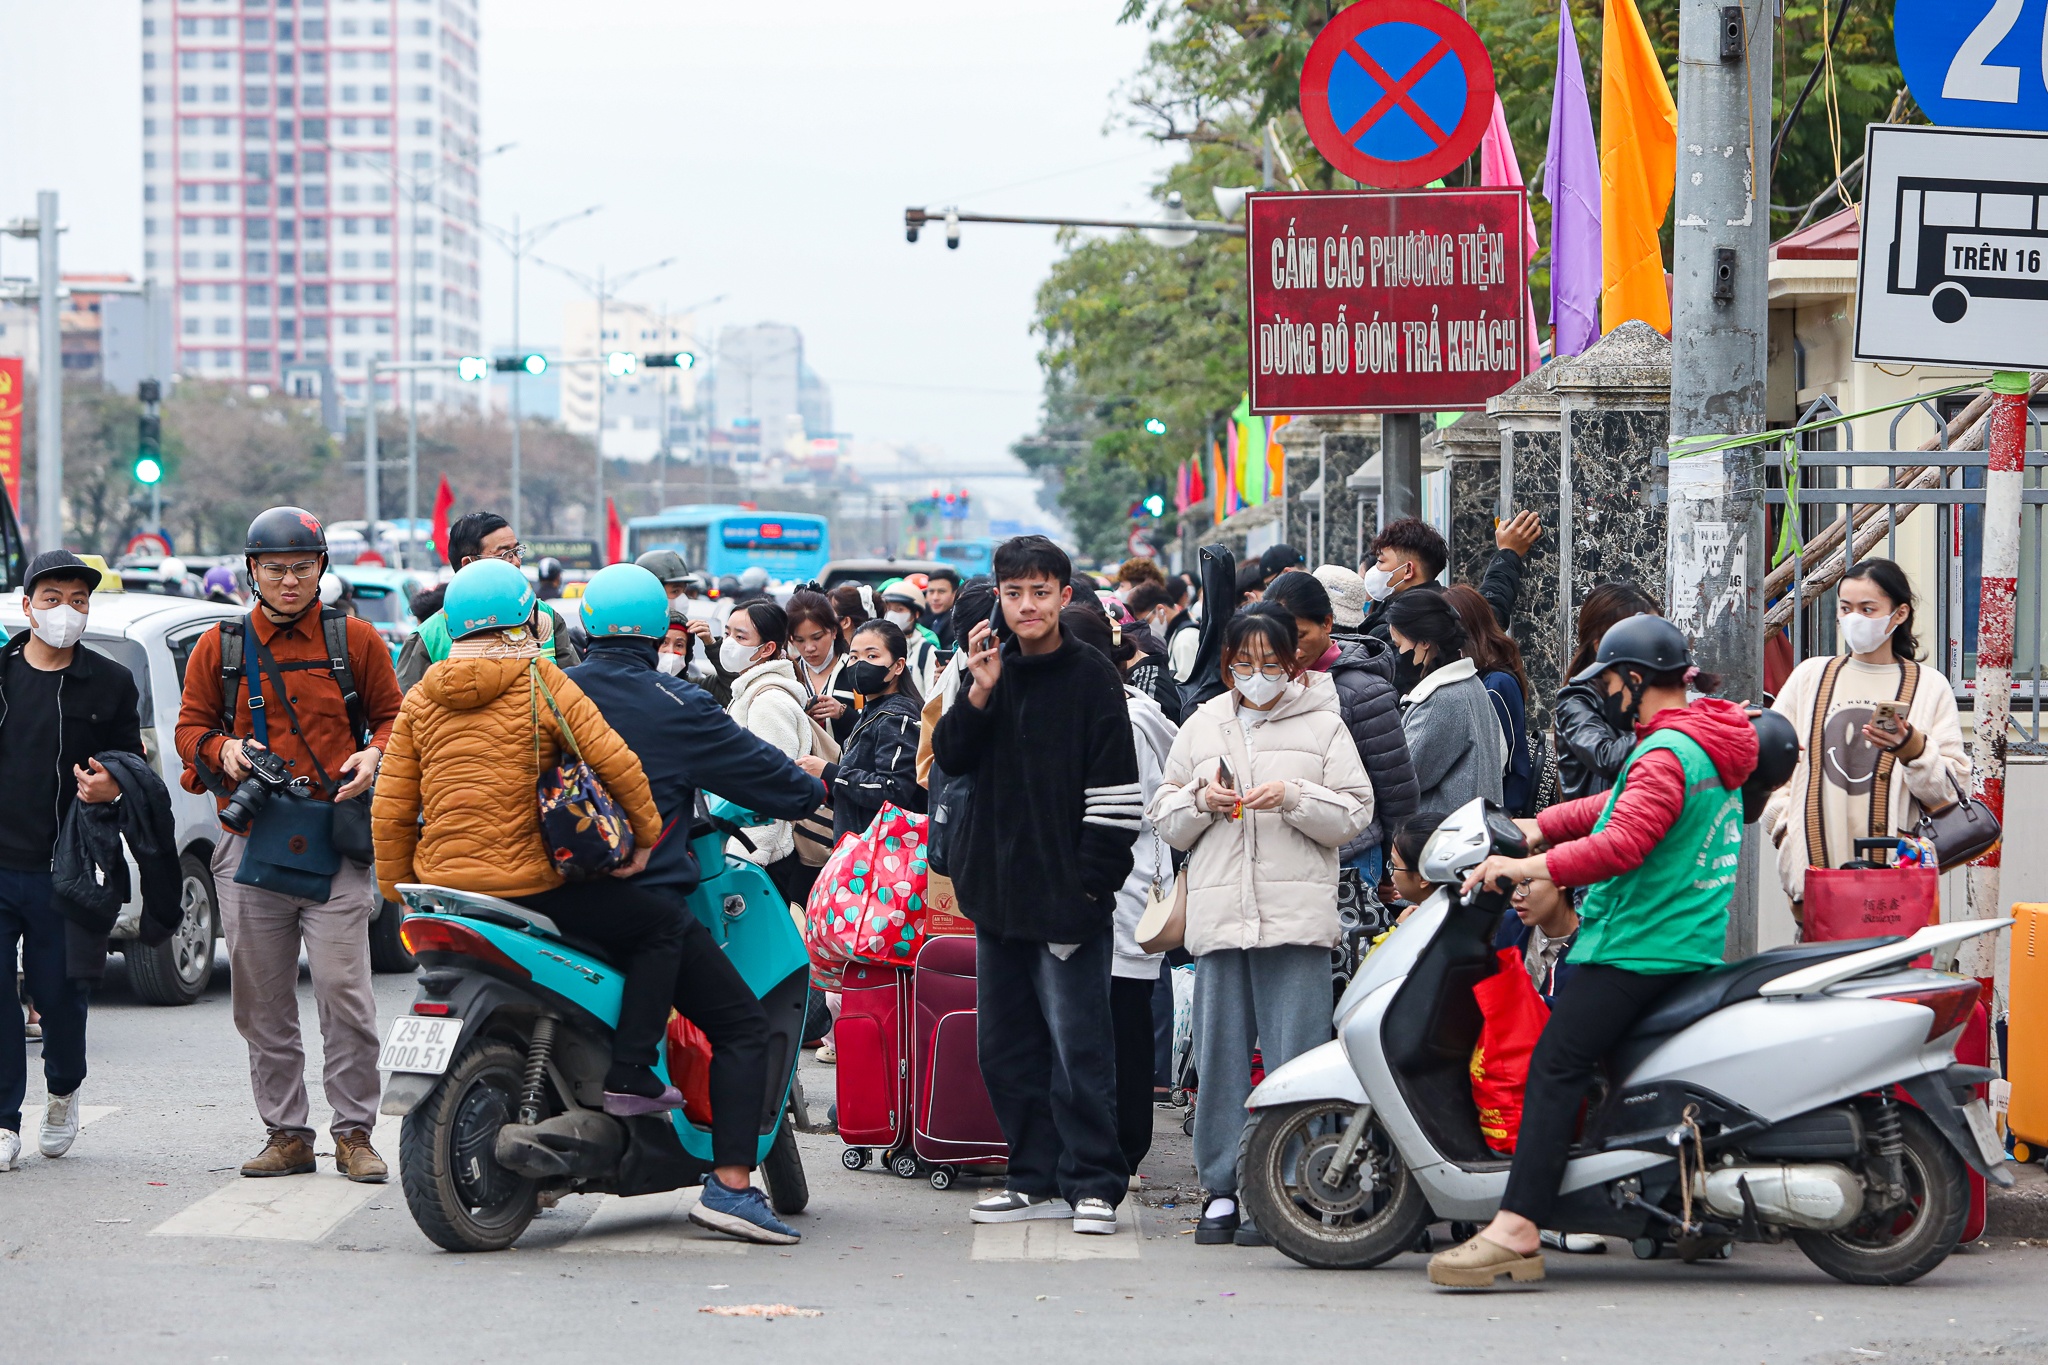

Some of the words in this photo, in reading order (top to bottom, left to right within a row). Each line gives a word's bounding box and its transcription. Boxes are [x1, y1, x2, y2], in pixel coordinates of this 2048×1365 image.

[1271, 217, 1317, 290] CẤM
[1323, 224, 1365, 288] CÁC
[1370, 229, 1454, 287] PHƯƠNG
[1458, 223, 1505, 291] TIỆN
[1952, 242, 2008, 273] TRÊN
[2015, 249, 2041, 274] 16
[1260, 313, 1316, 375] DỪNG
[1322, 304, 1349, 374] ĐỖ
[1355, 310, 1398, 373] ĐÓN
[1402, 304, 1443, 373] TRẢ
[1448, 309, 1516, 372] KHÁCH
[396, 1020, 446, 1044] 29-BL
[383, 1045, 447, 1070] 000.51
